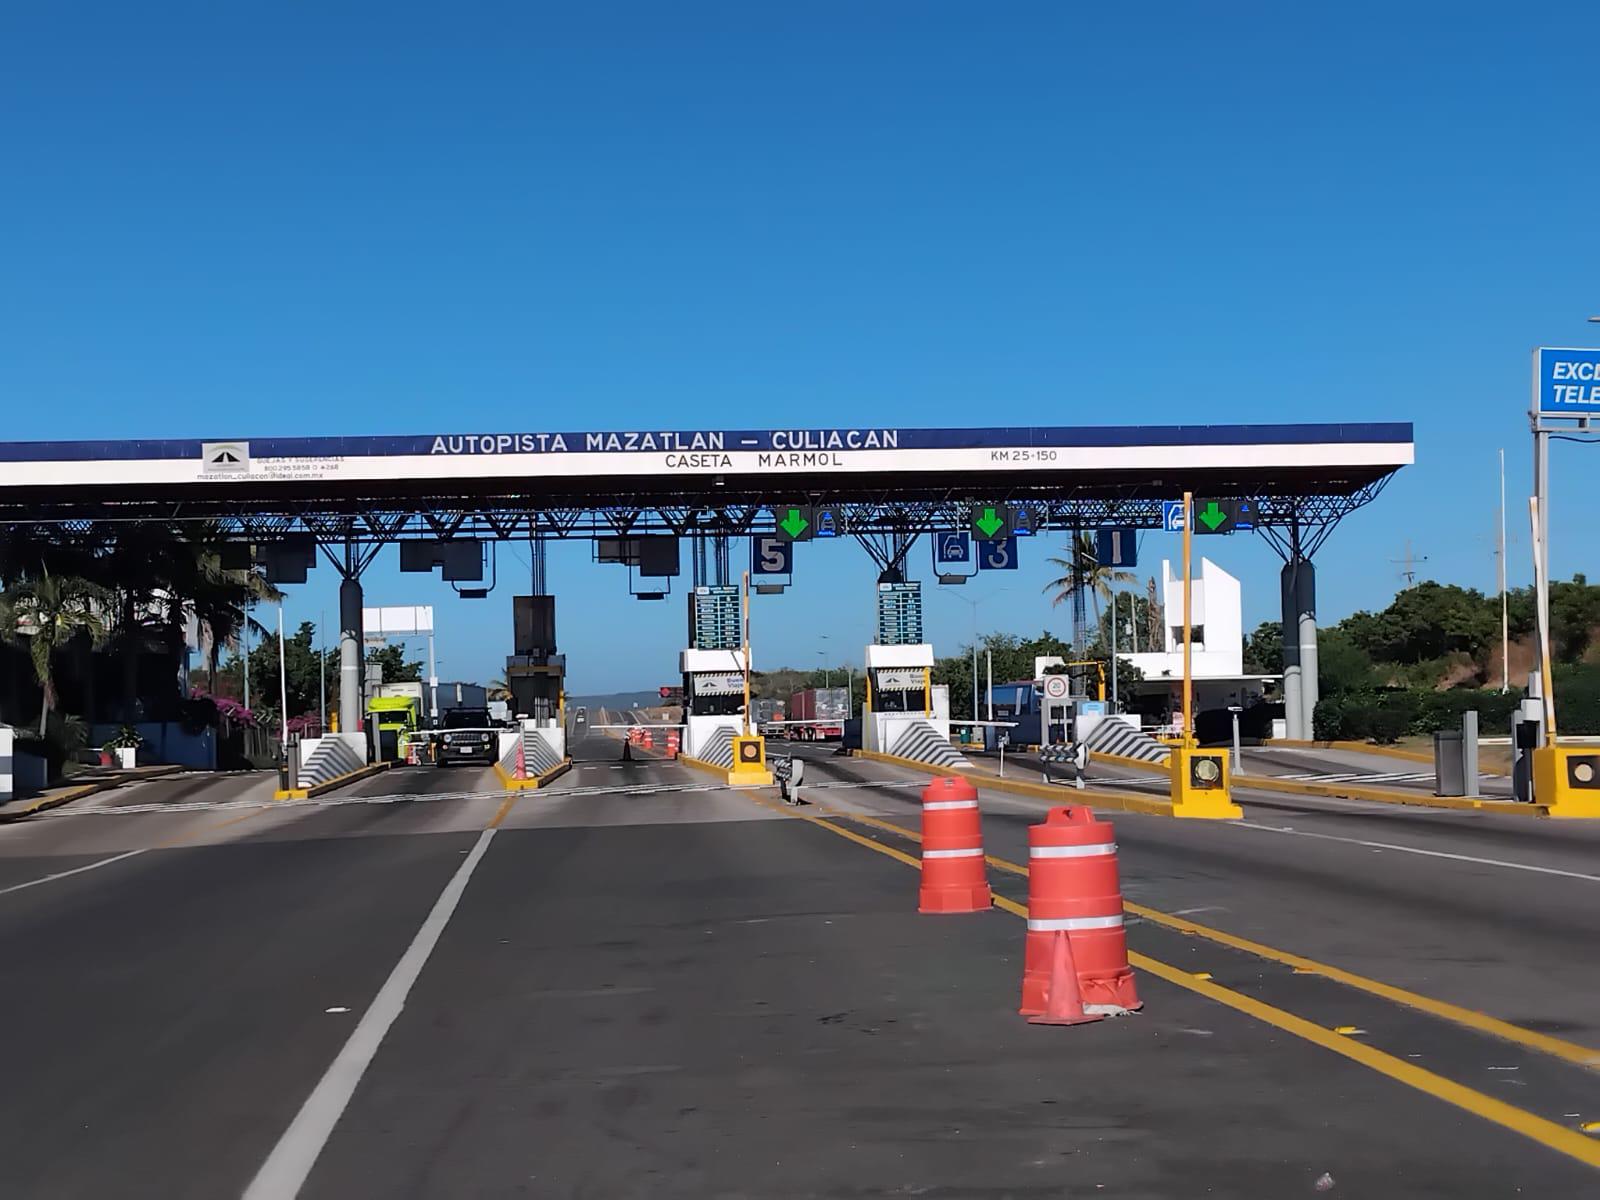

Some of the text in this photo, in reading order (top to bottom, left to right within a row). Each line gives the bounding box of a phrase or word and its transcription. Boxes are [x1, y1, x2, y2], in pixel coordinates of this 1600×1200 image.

[1553, 384, 1600, 405] TELE
[431, 433, 568, 454] AUTOPISTA
[586, 430, 725, 451] MAZATLAN
[771, 430, 898, 449] CULIACAN
[665, 452, 843, 468] CASETA MARMOL
[991, 450, 1009, 461] KM
[761, 538, 785, 571] 5
[988, 538, 1009, 569] 3
